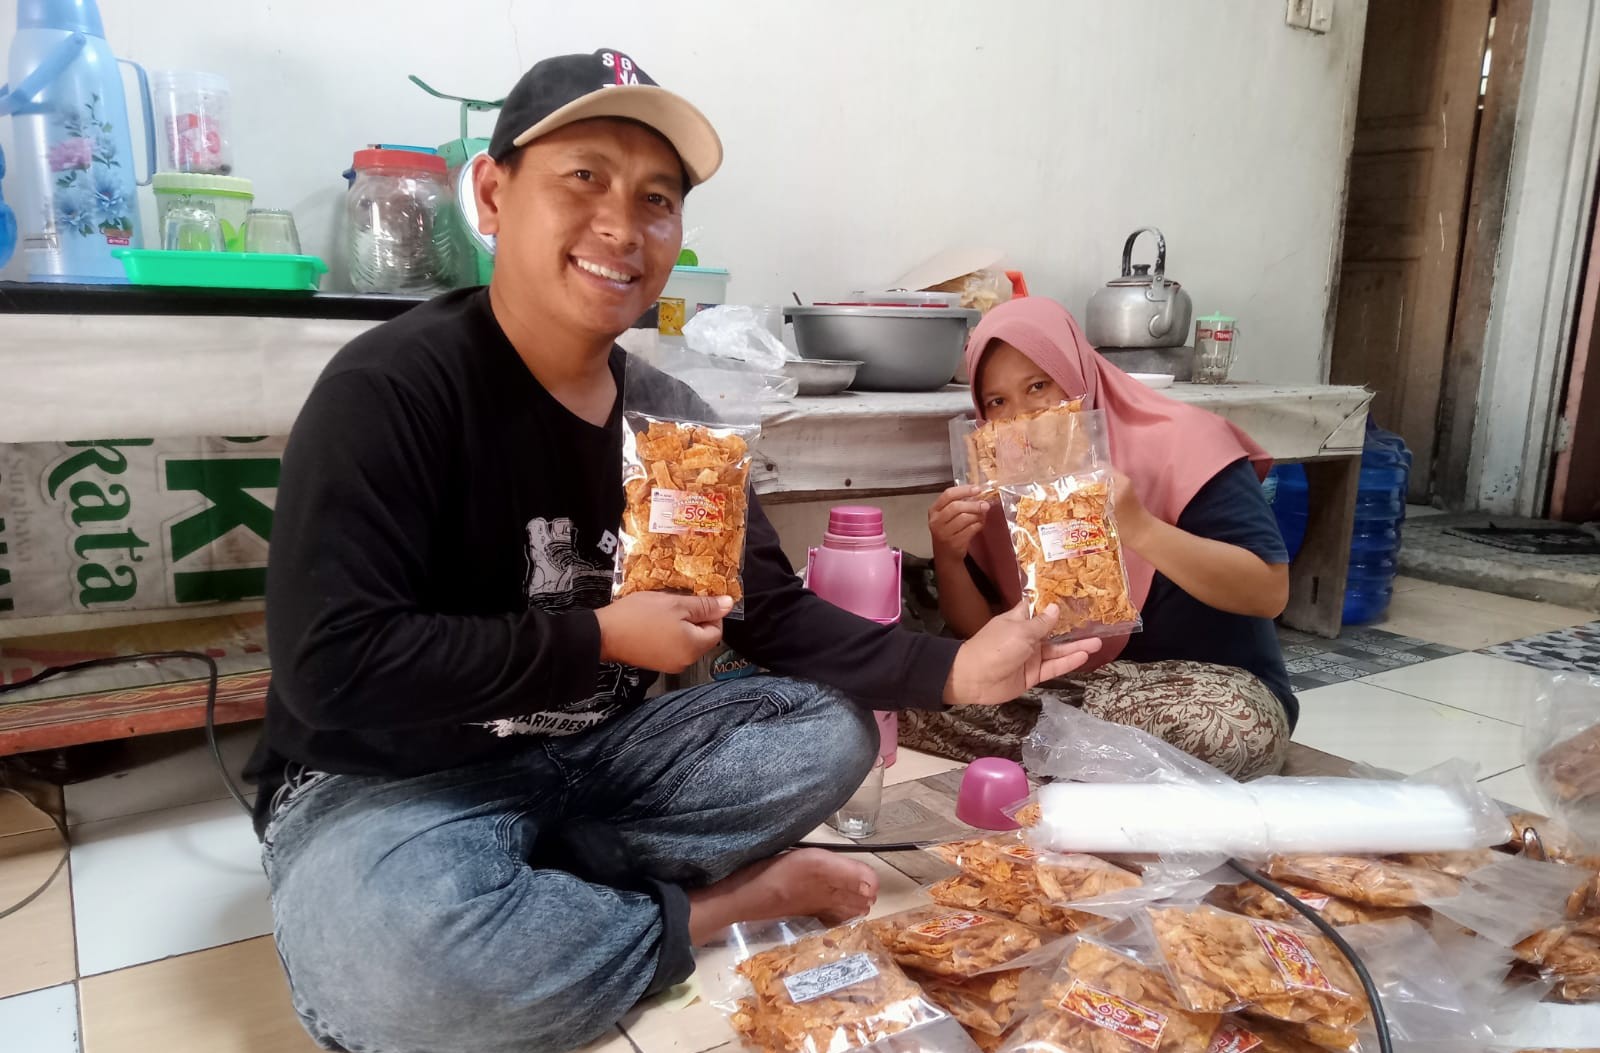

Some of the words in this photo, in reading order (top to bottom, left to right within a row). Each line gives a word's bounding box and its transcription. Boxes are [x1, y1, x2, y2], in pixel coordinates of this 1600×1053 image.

[164, 436, 280, 604] KI
[684, 505, 708, 520] 59
[1070, 530, 1090, 543] 59
[1097, 1003, 1130, 1022] 59
